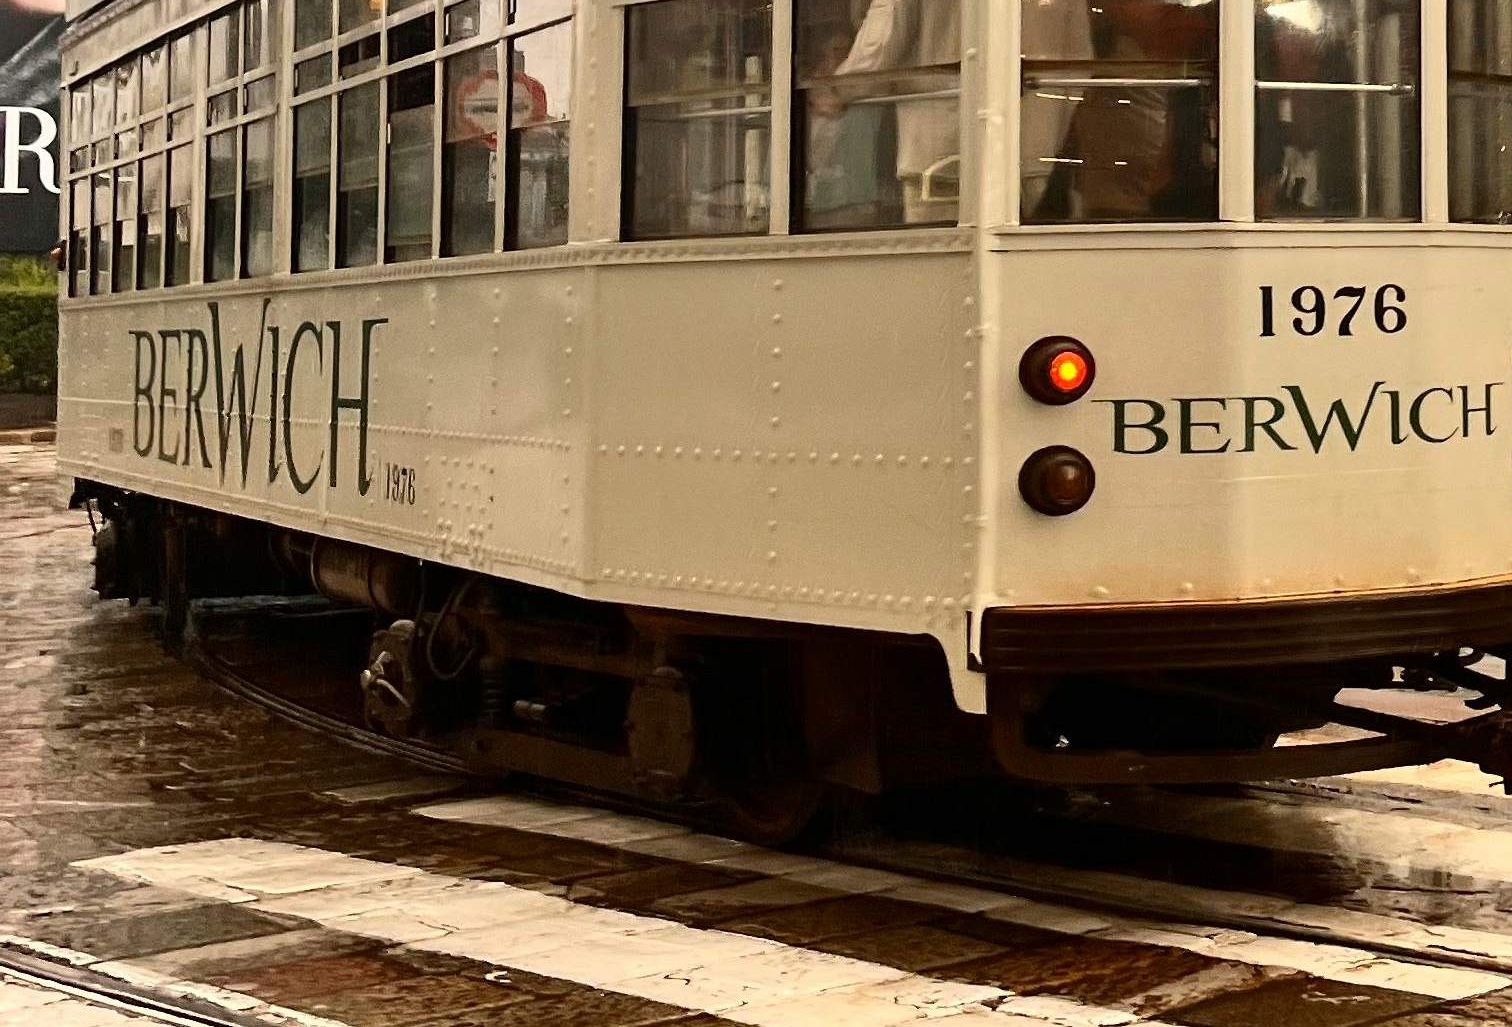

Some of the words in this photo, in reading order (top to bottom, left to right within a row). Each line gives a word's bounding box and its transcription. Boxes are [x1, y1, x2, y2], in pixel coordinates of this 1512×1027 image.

[0, 106, 60, 193] R
[1259, 284, 1408, 337] 1976
[128, 298, 389, 497] BERWICH
[1091, 381, 1504, 454] BERWICH
[385, 462, 416, 505] 1976
